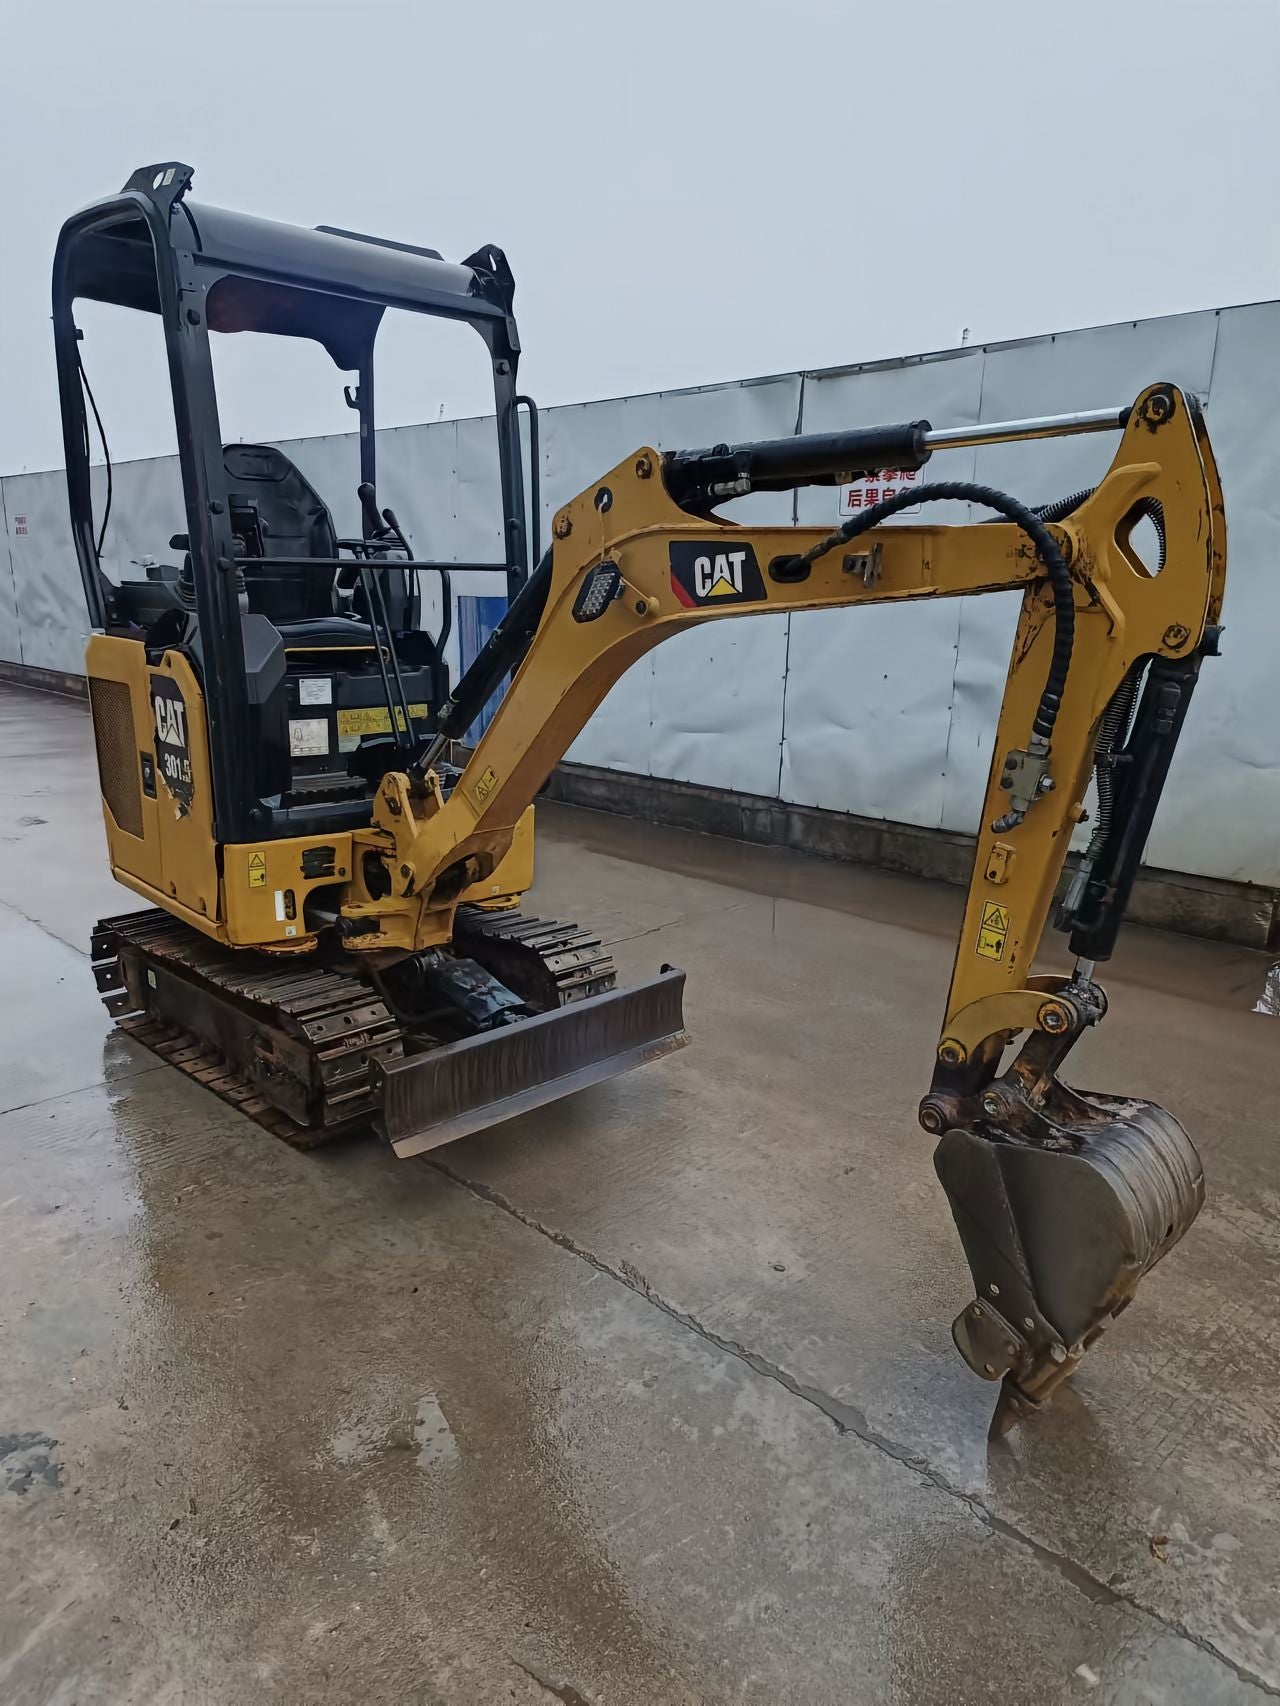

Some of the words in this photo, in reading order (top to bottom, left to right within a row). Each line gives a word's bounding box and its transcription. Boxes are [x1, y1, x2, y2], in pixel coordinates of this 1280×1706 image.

[847, 486, 912, 508] 后果自
[694, 551, 746, 598] CAT
[154, 695, 186, 748] CAT
